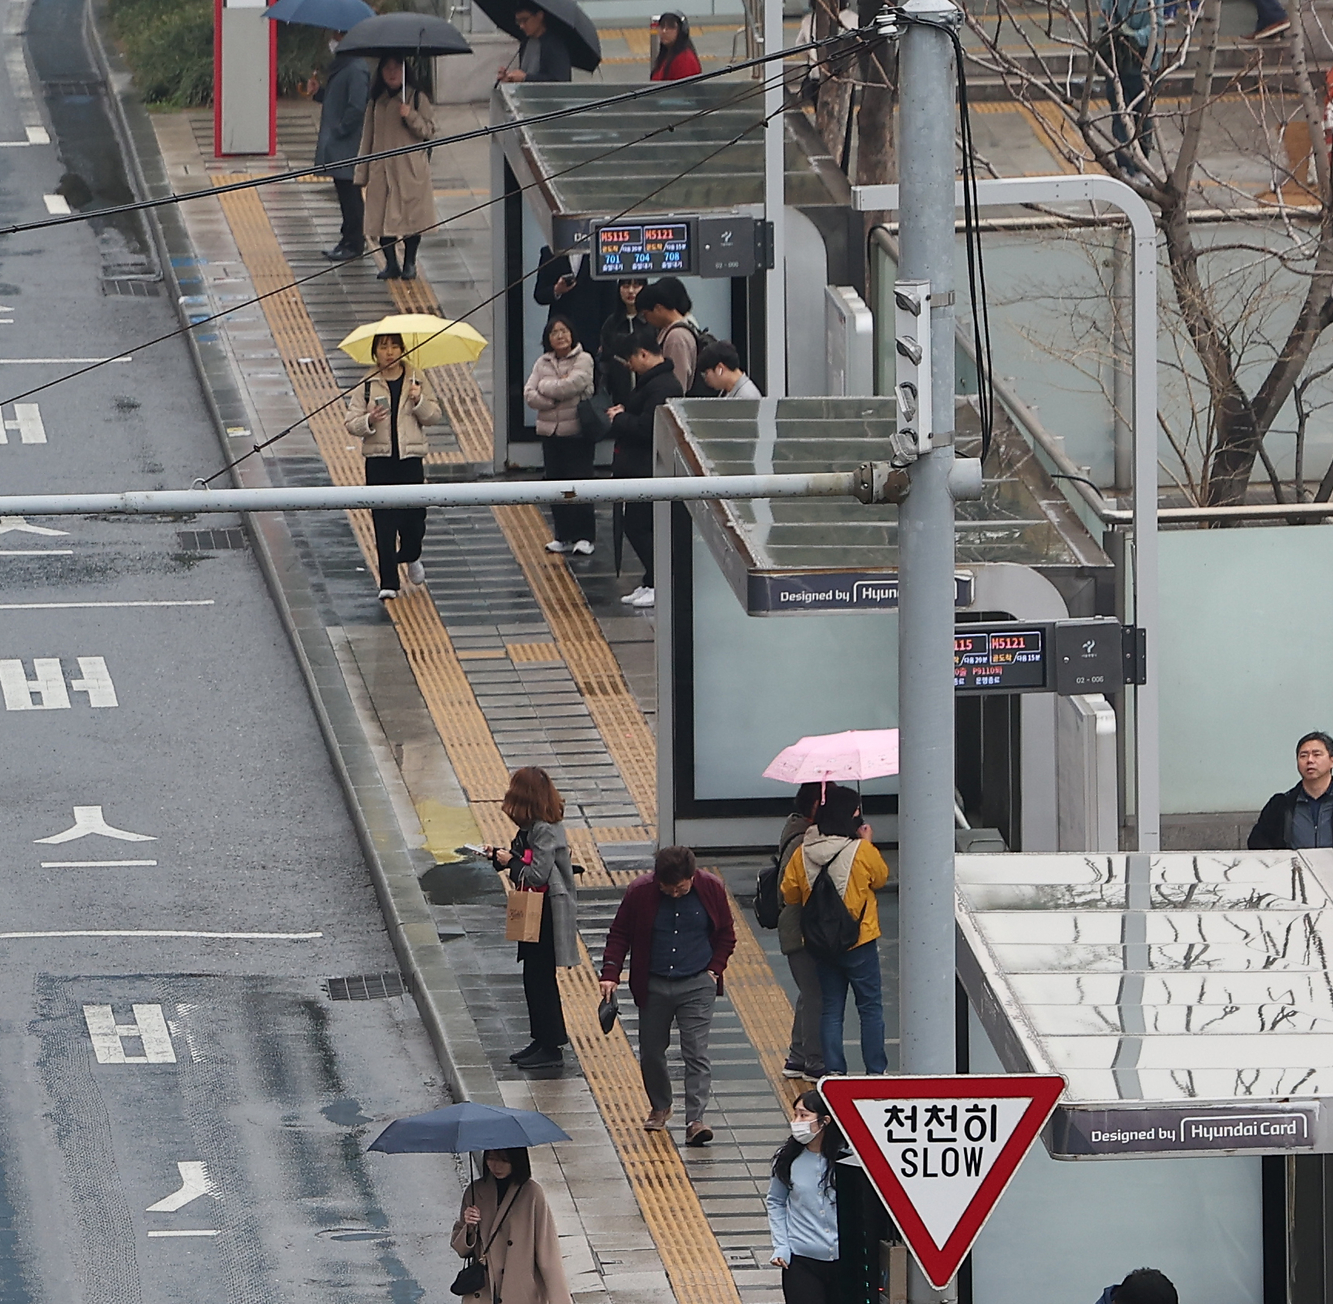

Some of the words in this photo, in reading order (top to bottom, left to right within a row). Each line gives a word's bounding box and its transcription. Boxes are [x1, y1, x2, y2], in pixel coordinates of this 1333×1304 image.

[605, 254, 620, 264] 701
[634, 253, 650, 262] 704
[664, 252, 680, 261] 708
[780, 590, 833, 604] Designed
[835, 589, 850, 603] by
[862, 587, 899, 600] Hyun
[884, 1103, 998, 1143] 천천히
[1091, 1127, 1156, 1144] Designed
[1158, 1127, 1176, 1143] by
[1191, 1122, 1258, 1142] Hyundai
[1260, 1119, 1297, 1136] Card
[900, 1146, 984, 1178] SLOW
